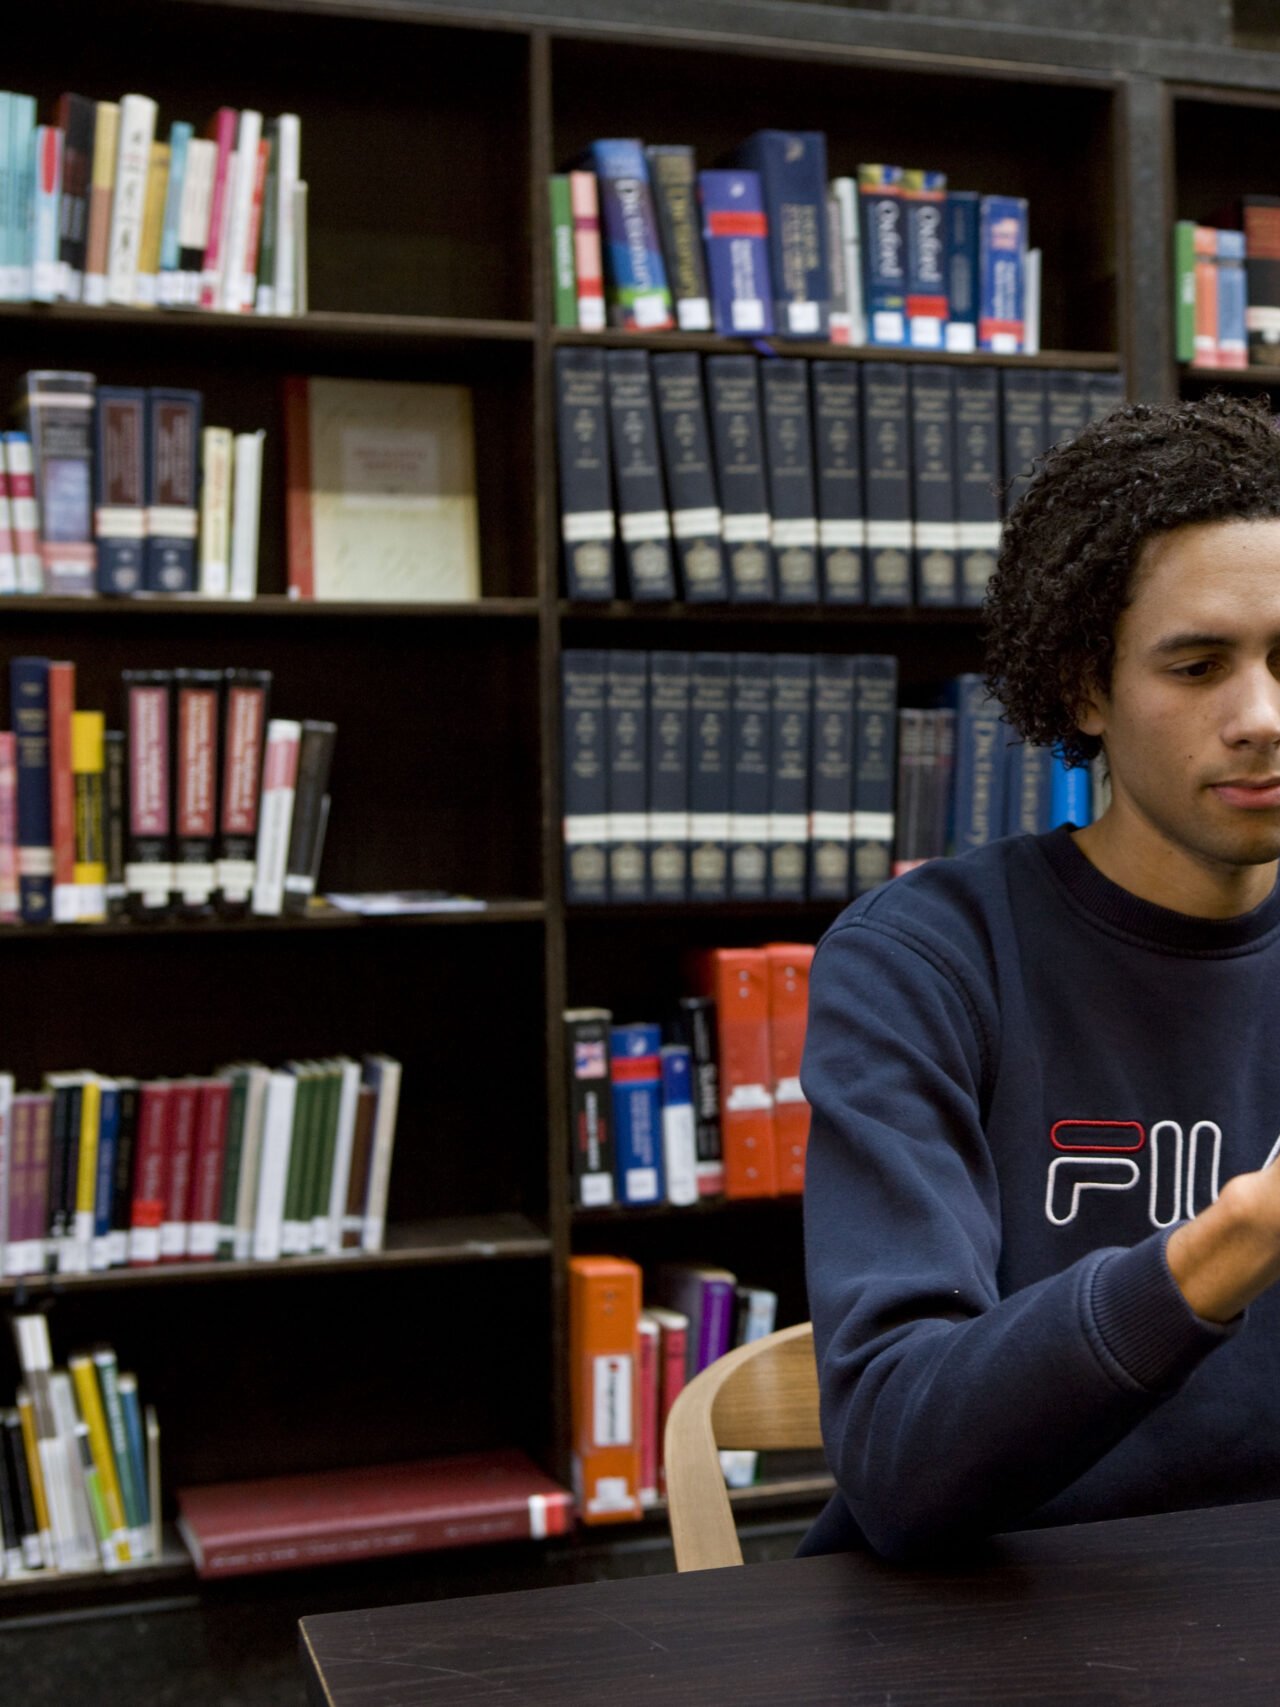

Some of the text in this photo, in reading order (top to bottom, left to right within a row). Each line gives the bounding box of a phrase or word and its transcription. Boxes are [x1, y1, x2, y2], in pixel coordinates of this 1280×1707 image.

[876, 199, 903, 278] Oxford
[916, 206, 943, 283] Oxford
[967, 721, 996, 846] Dictionary
